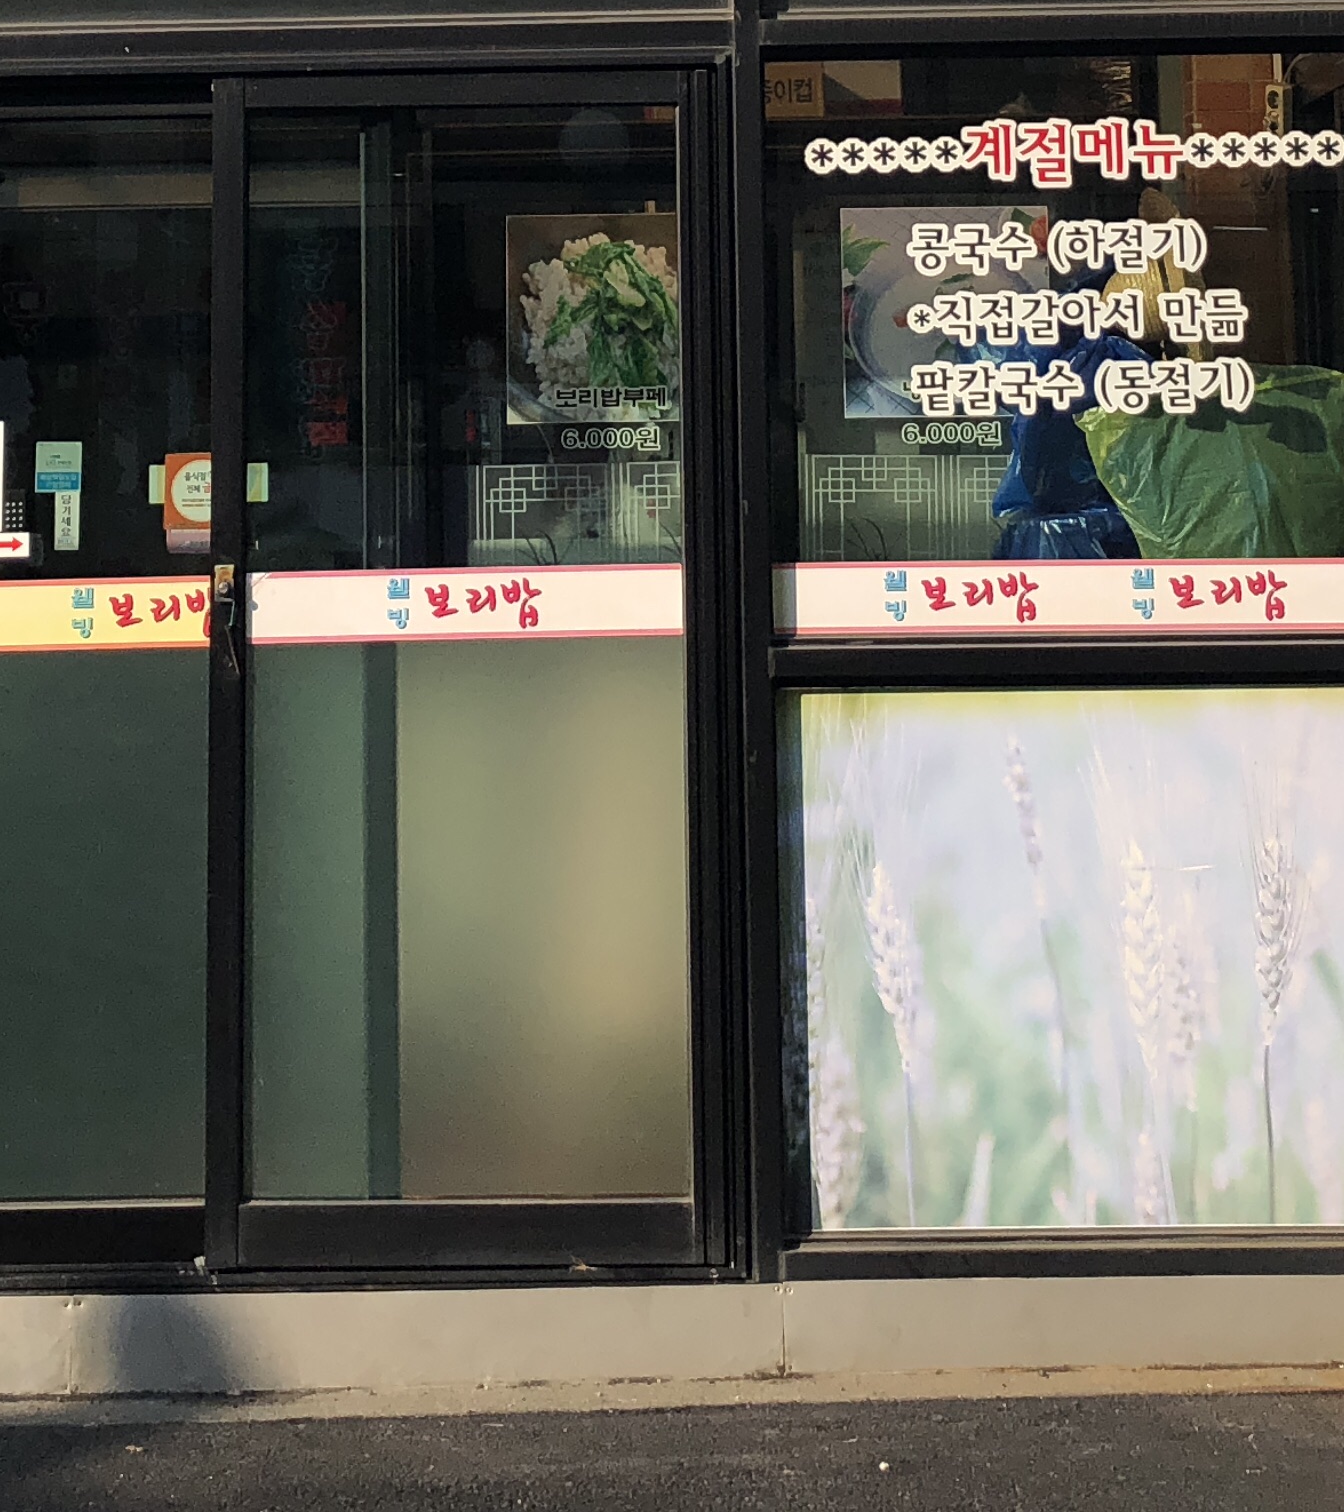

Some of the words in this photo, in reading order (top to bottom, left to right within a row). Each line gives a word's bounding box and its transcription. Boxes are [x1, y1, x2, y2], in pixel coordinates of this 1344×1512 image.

[907, 223, 1037, 274] 콩국수
[1048, 219, 1207, 273] (하절기)
[555, 386, 668, 410] 보리밥부페
[913, 362, 1084, 416] 팥칼국수
[1094, 359, 1254, 415] (동절기)
[561, 427, 661, 451] 6.000원
[901, 421, 1002, 446] 6.000원
[424, 578, 542, 628] 보리밥
[921, 571, 1039, 622] 보리밥
[1168, 570, 1288, 620] 보리밥
